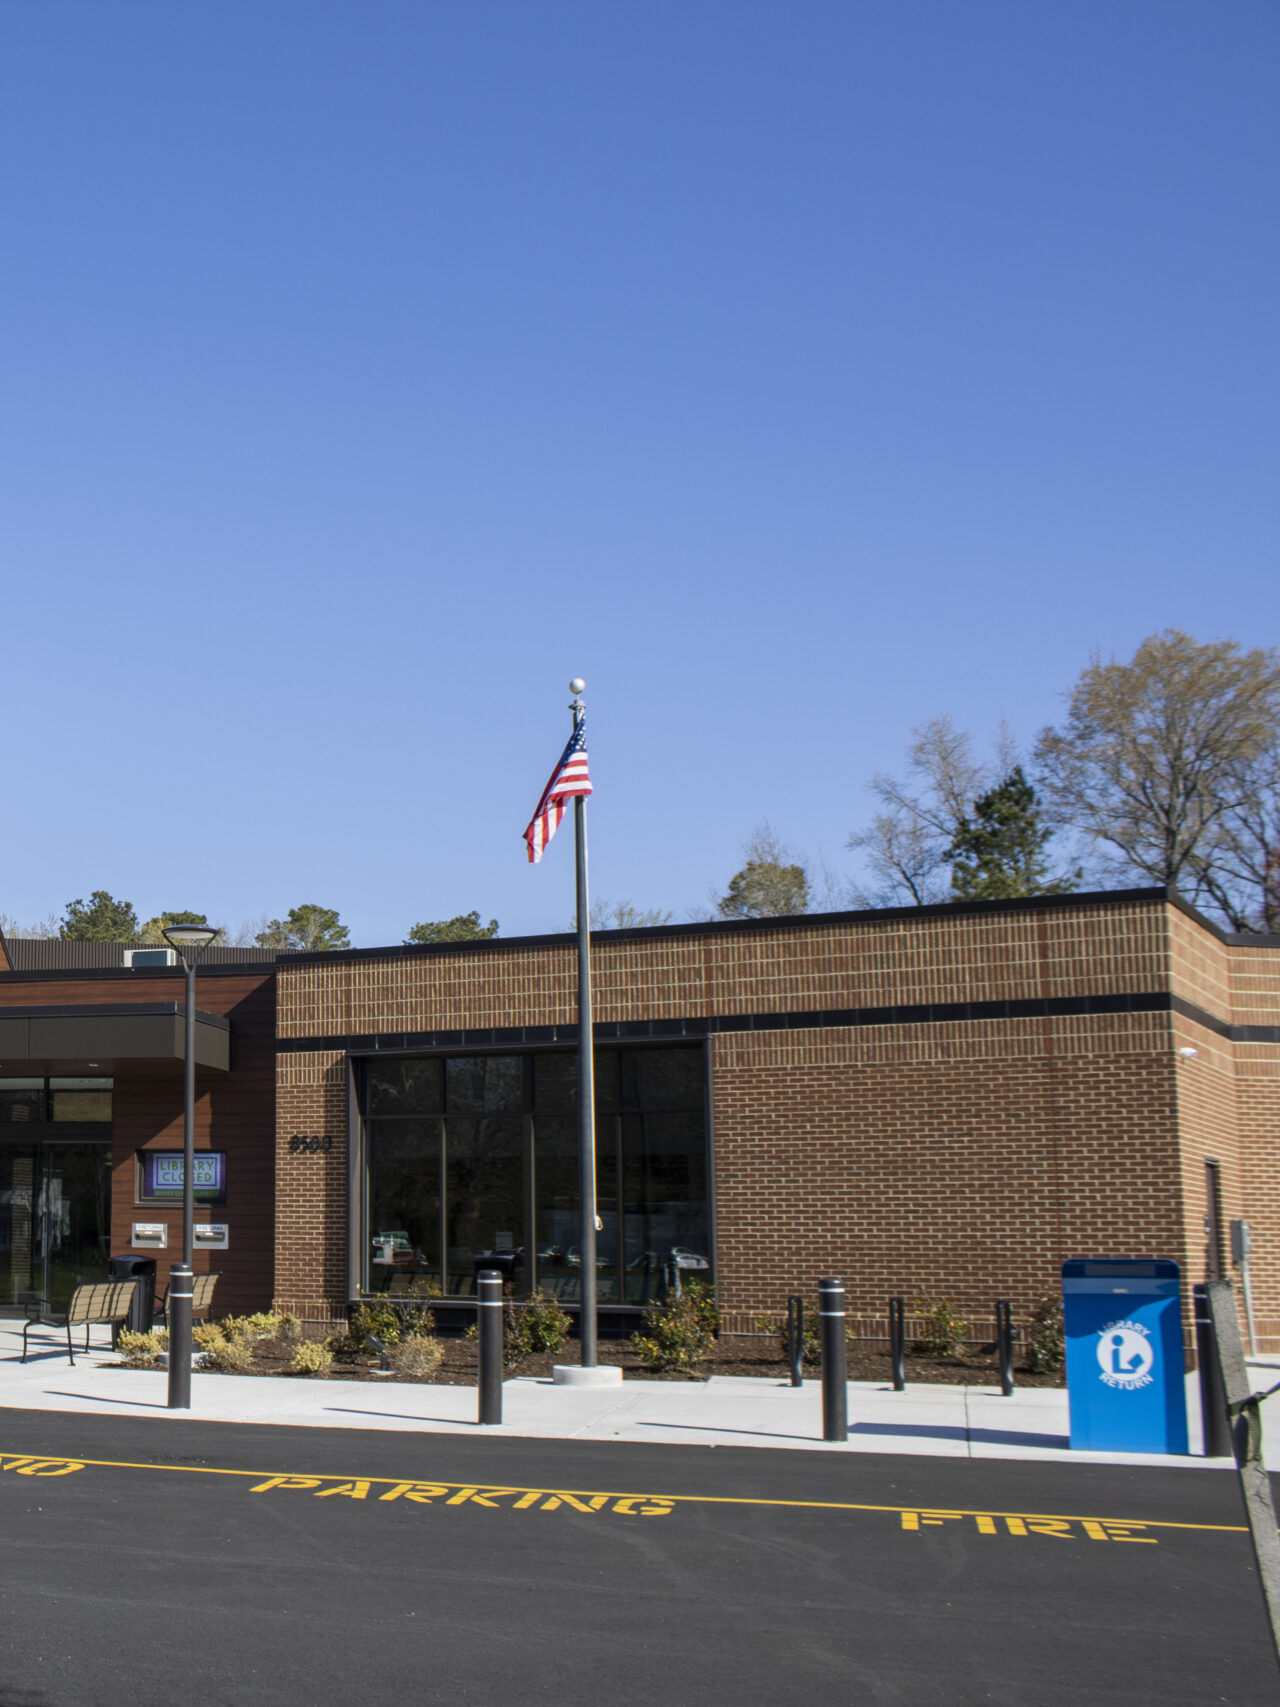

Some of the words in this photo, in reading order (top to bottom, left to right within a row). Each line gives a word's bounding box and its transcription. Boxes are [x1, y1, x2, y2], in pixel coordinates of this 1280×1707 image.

[290, 1135, 333, 1152] 8500
[1097, 1320, 1152, 1336] LIBRARY
[1099, 1373, 1153, 1390] RETURN
[249, 1477, 677, 1516] PARKING
[901, 1512, 1159, 1543] FIRE
